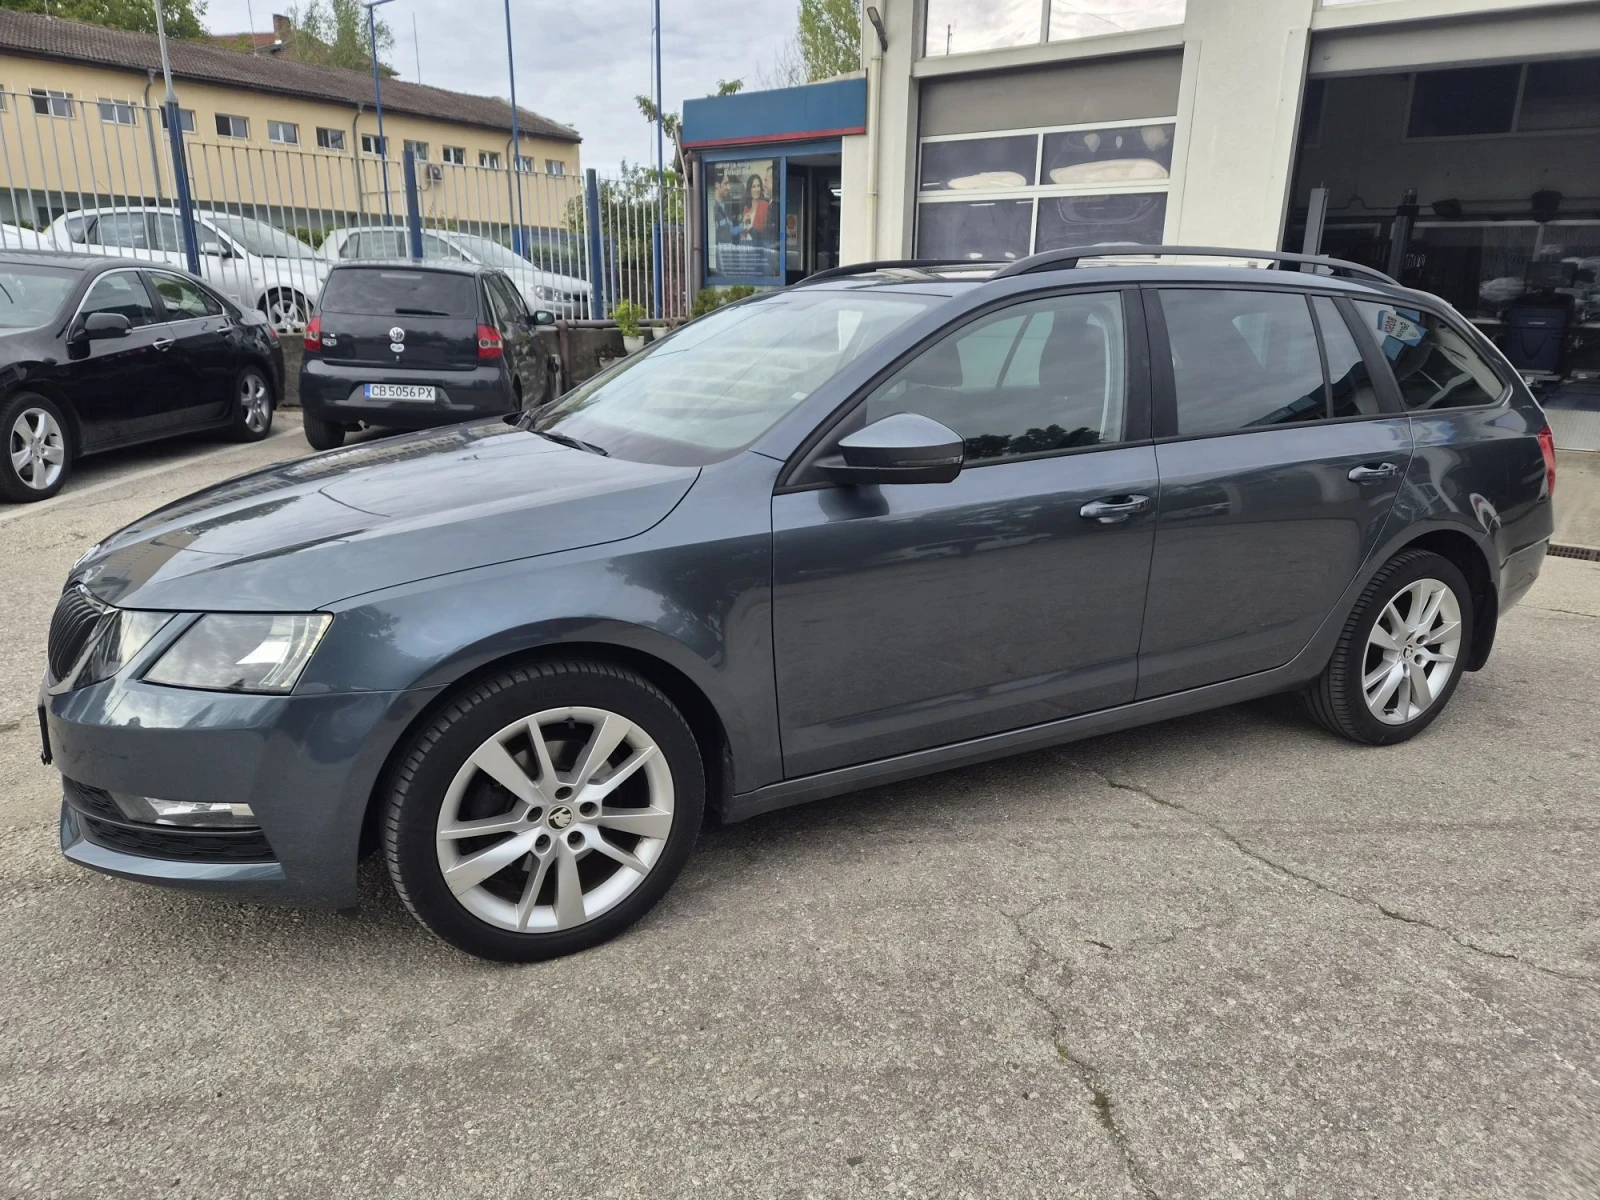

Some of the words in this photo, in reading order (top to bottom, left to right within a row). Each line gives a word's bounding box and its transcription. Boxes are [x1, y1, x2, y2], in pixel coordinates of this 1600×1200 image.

[372, 385, 386, 397] CB
[388, 386, 415, 398] 5056
[418, 387, 433, 399] PX
